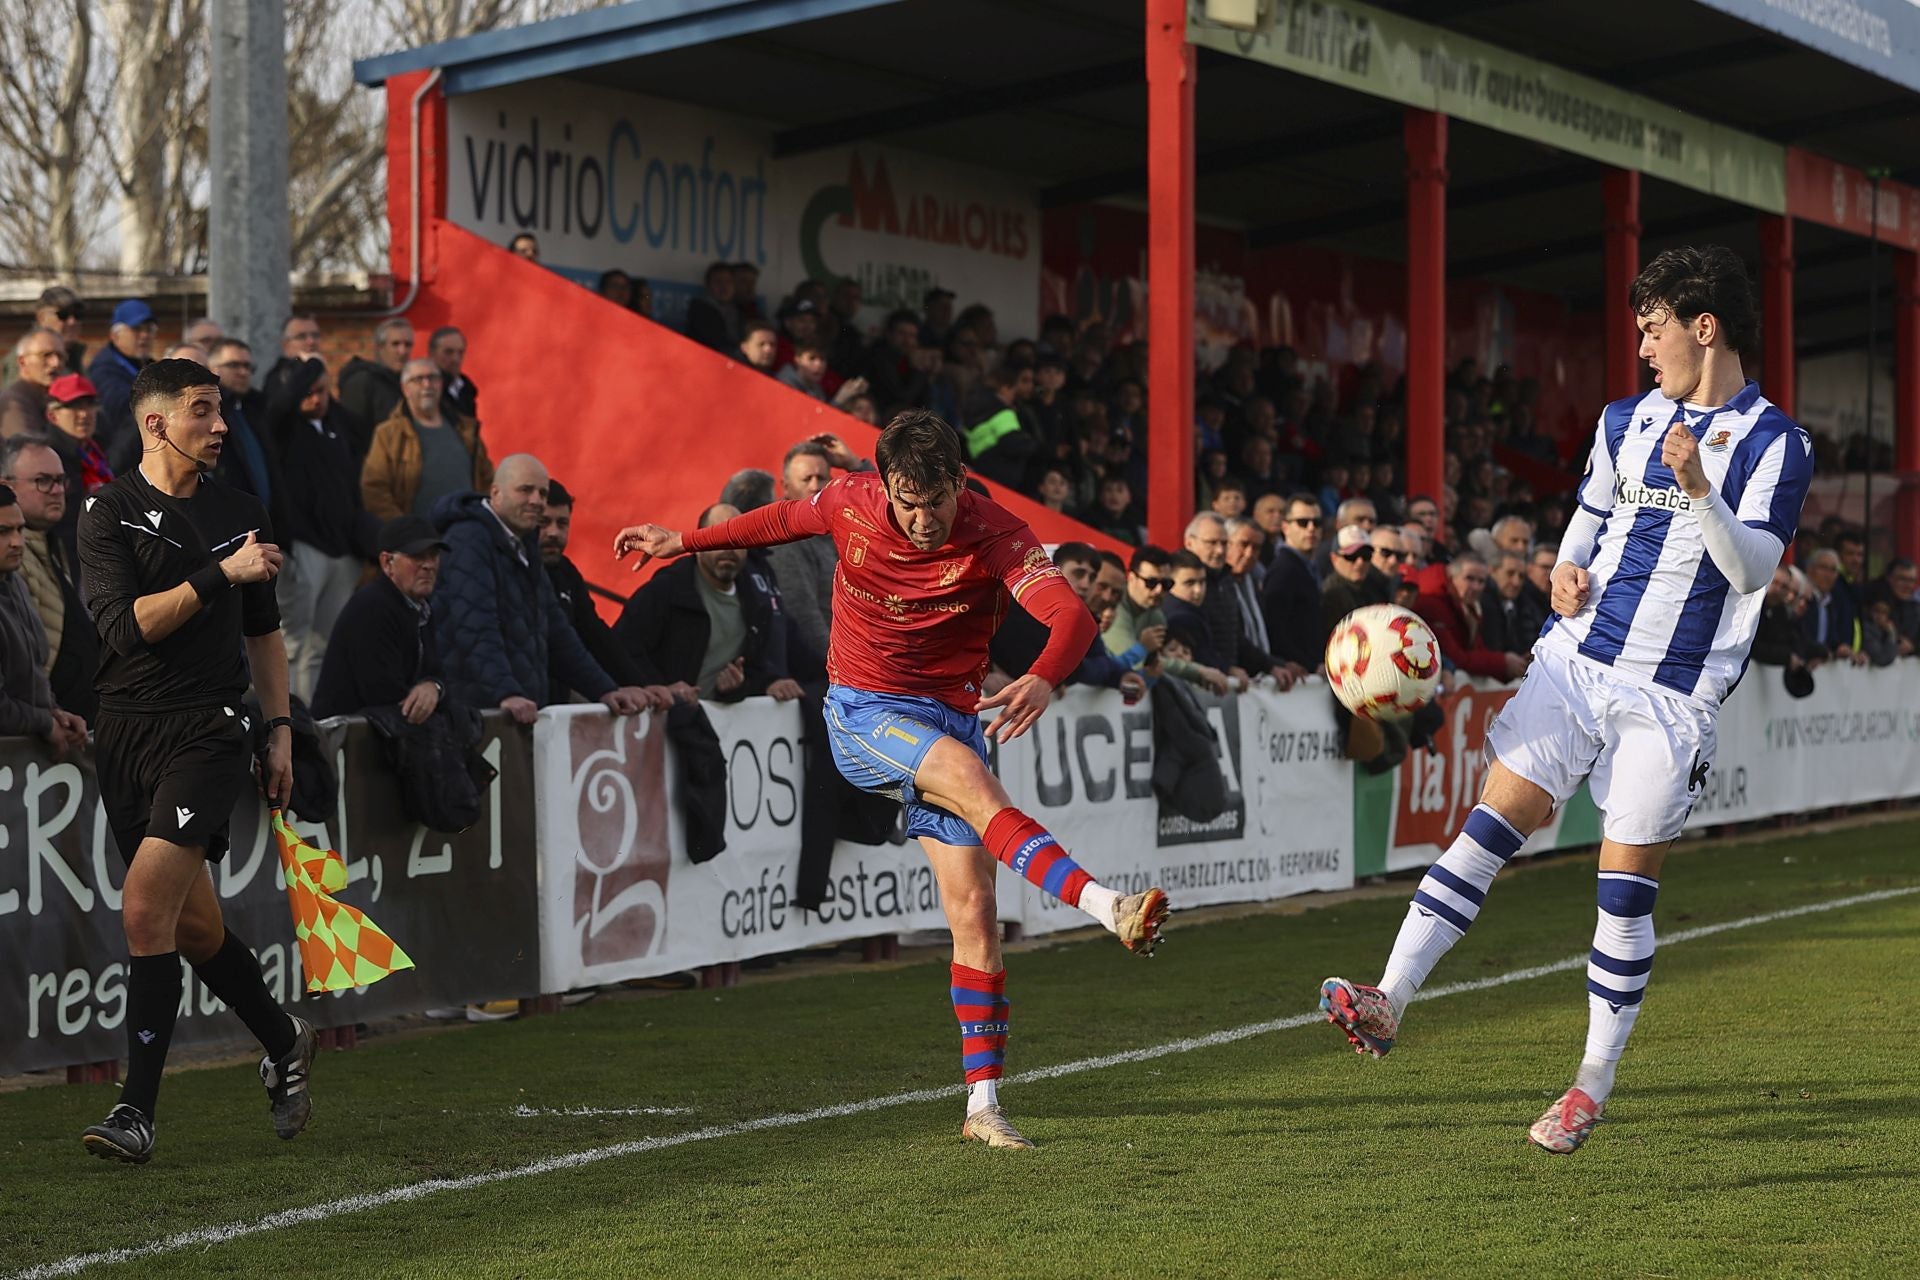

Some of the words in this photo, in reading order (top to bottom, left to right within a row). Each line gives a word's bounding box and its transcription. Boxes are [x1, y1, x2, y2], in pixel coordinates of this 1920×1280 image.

[465, 110, 767, 266] vidrioConfort
[836, 148, 1030, 260] MARMOLES
[1614, 468, 1694, 513] Kutxaba
